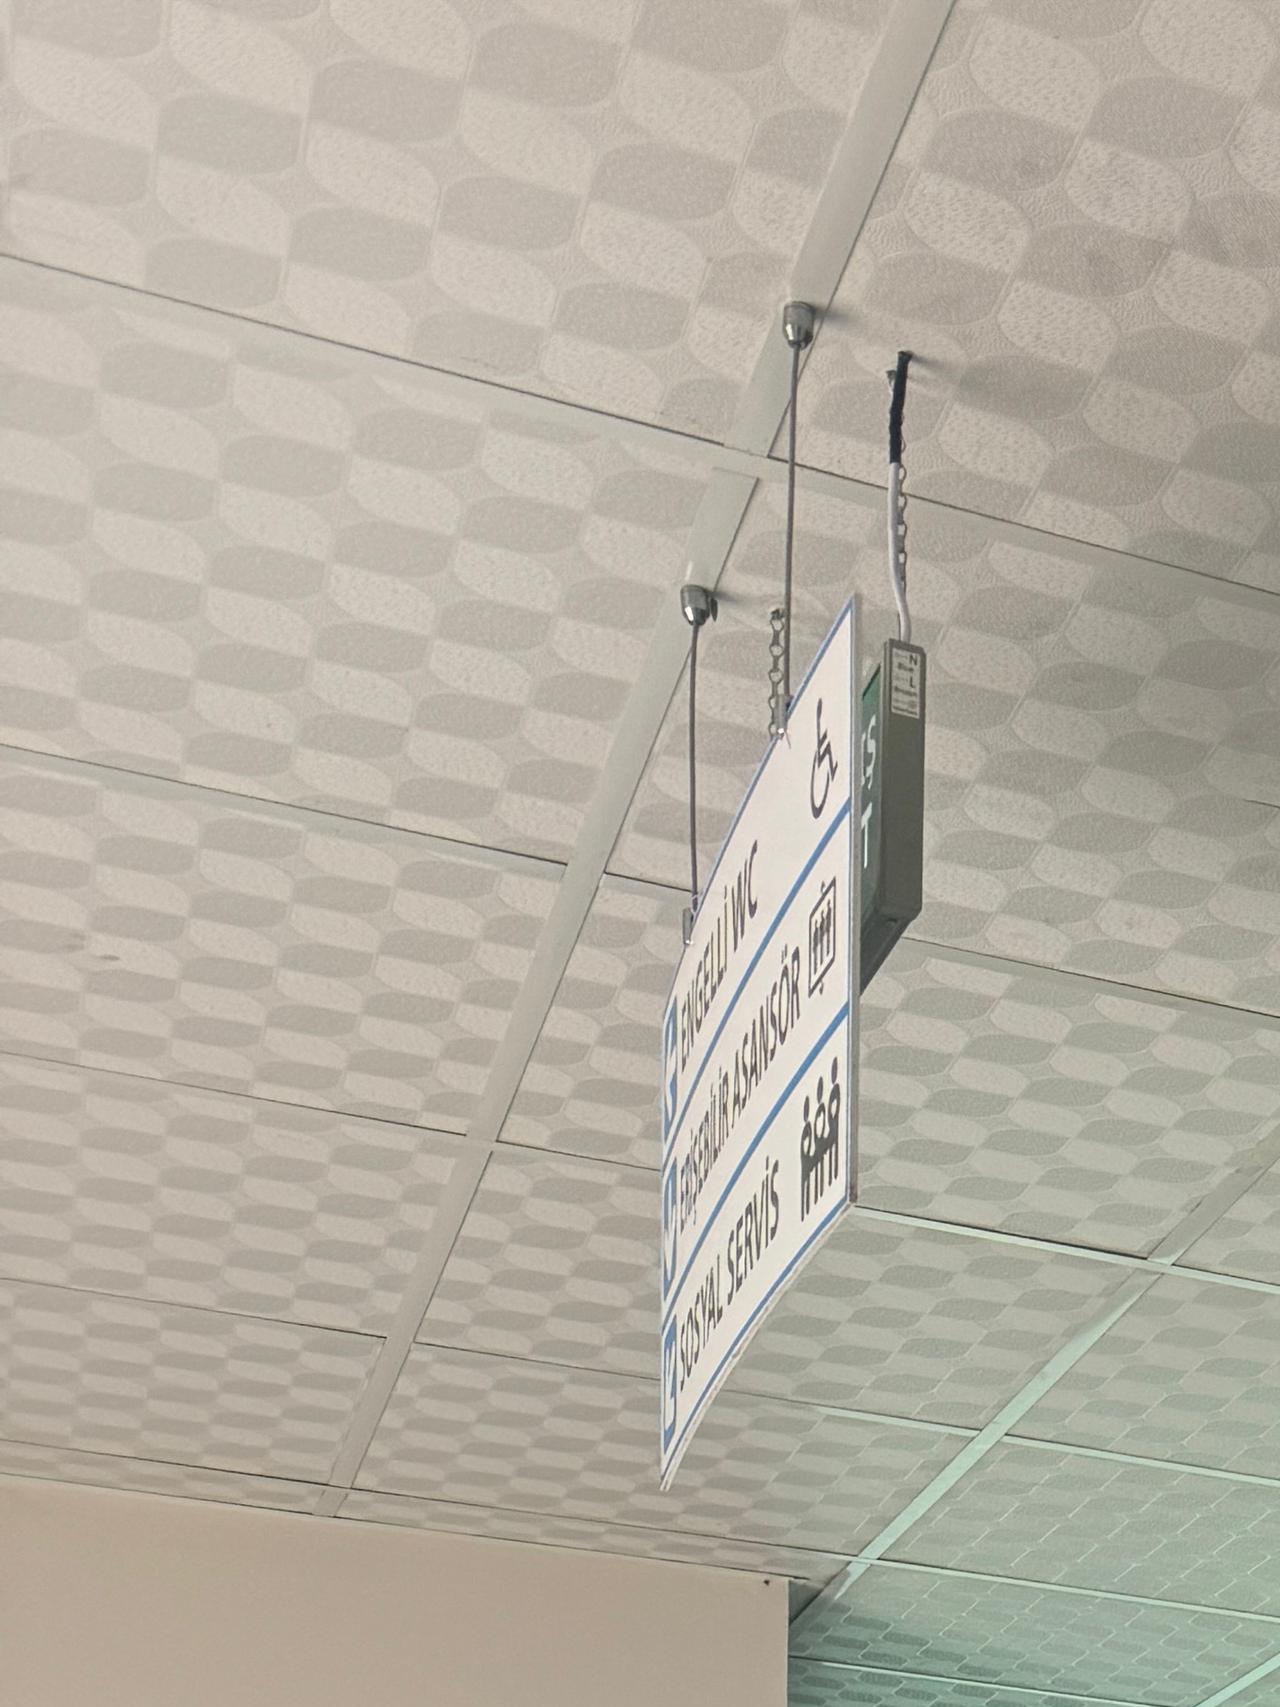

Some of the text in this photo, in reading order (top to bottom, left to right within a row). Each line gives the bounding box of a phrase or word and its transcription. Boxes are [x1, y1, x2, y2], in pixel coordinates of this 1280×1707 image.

[681, 839, 758, 1074] ENGELLİ WC
[680, 943, 801, 1236] ERİŞEBİLİR ASANSÖR
[680, 1155, 780, 1393] SOSYAL SERVİS
